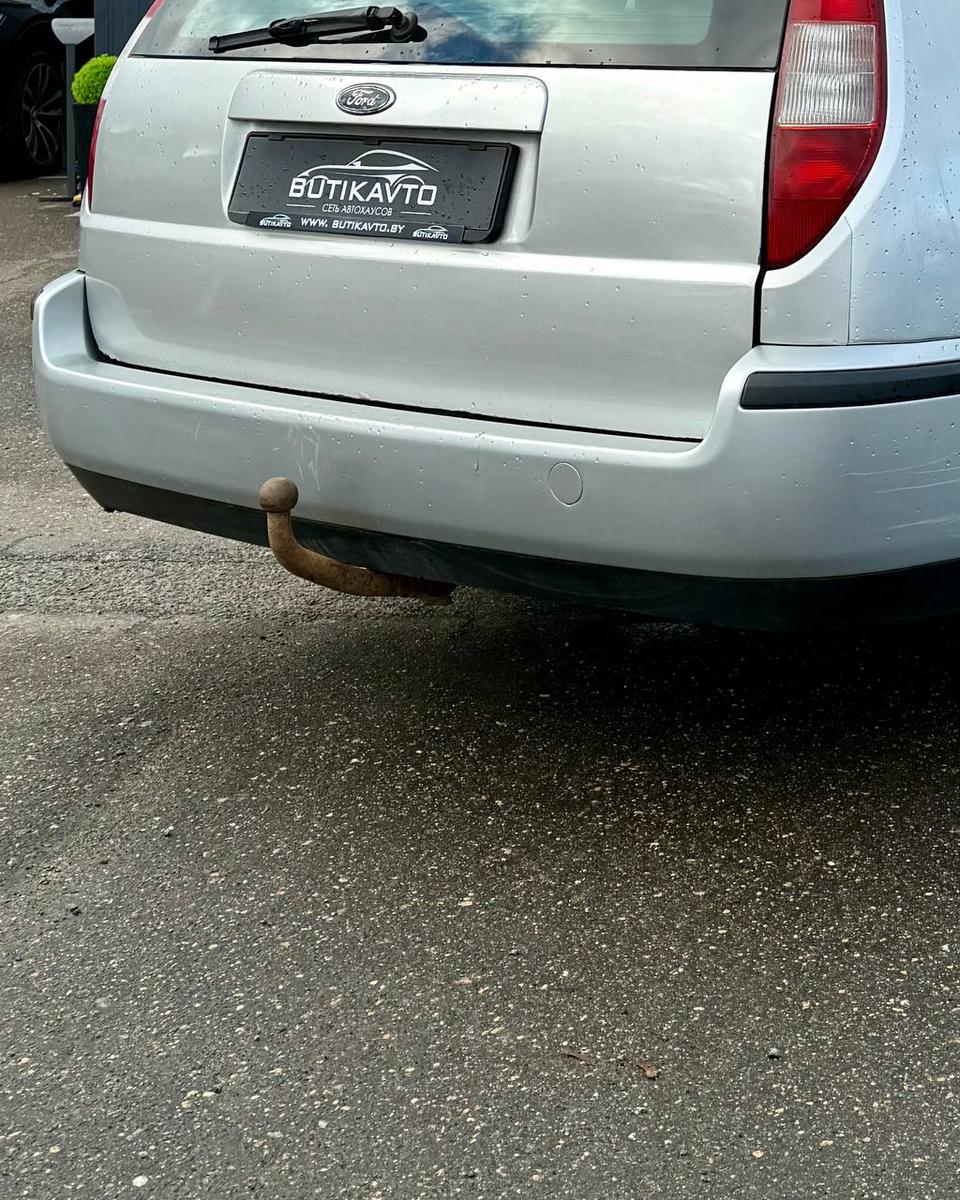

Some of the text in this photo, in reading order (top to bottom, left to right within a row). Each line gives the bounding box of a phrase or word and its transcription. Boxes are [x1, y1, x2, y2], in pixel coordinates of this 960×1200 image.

[346, 89, 381, 106] Ford
[288, 175, 438, 206] BUTIKAVTO
[321, 203, 393, 217] СЕТЬ АВТОХАУСОВ
[301, 217, 405, 234] WWW. BUTIKAVTO.BY
